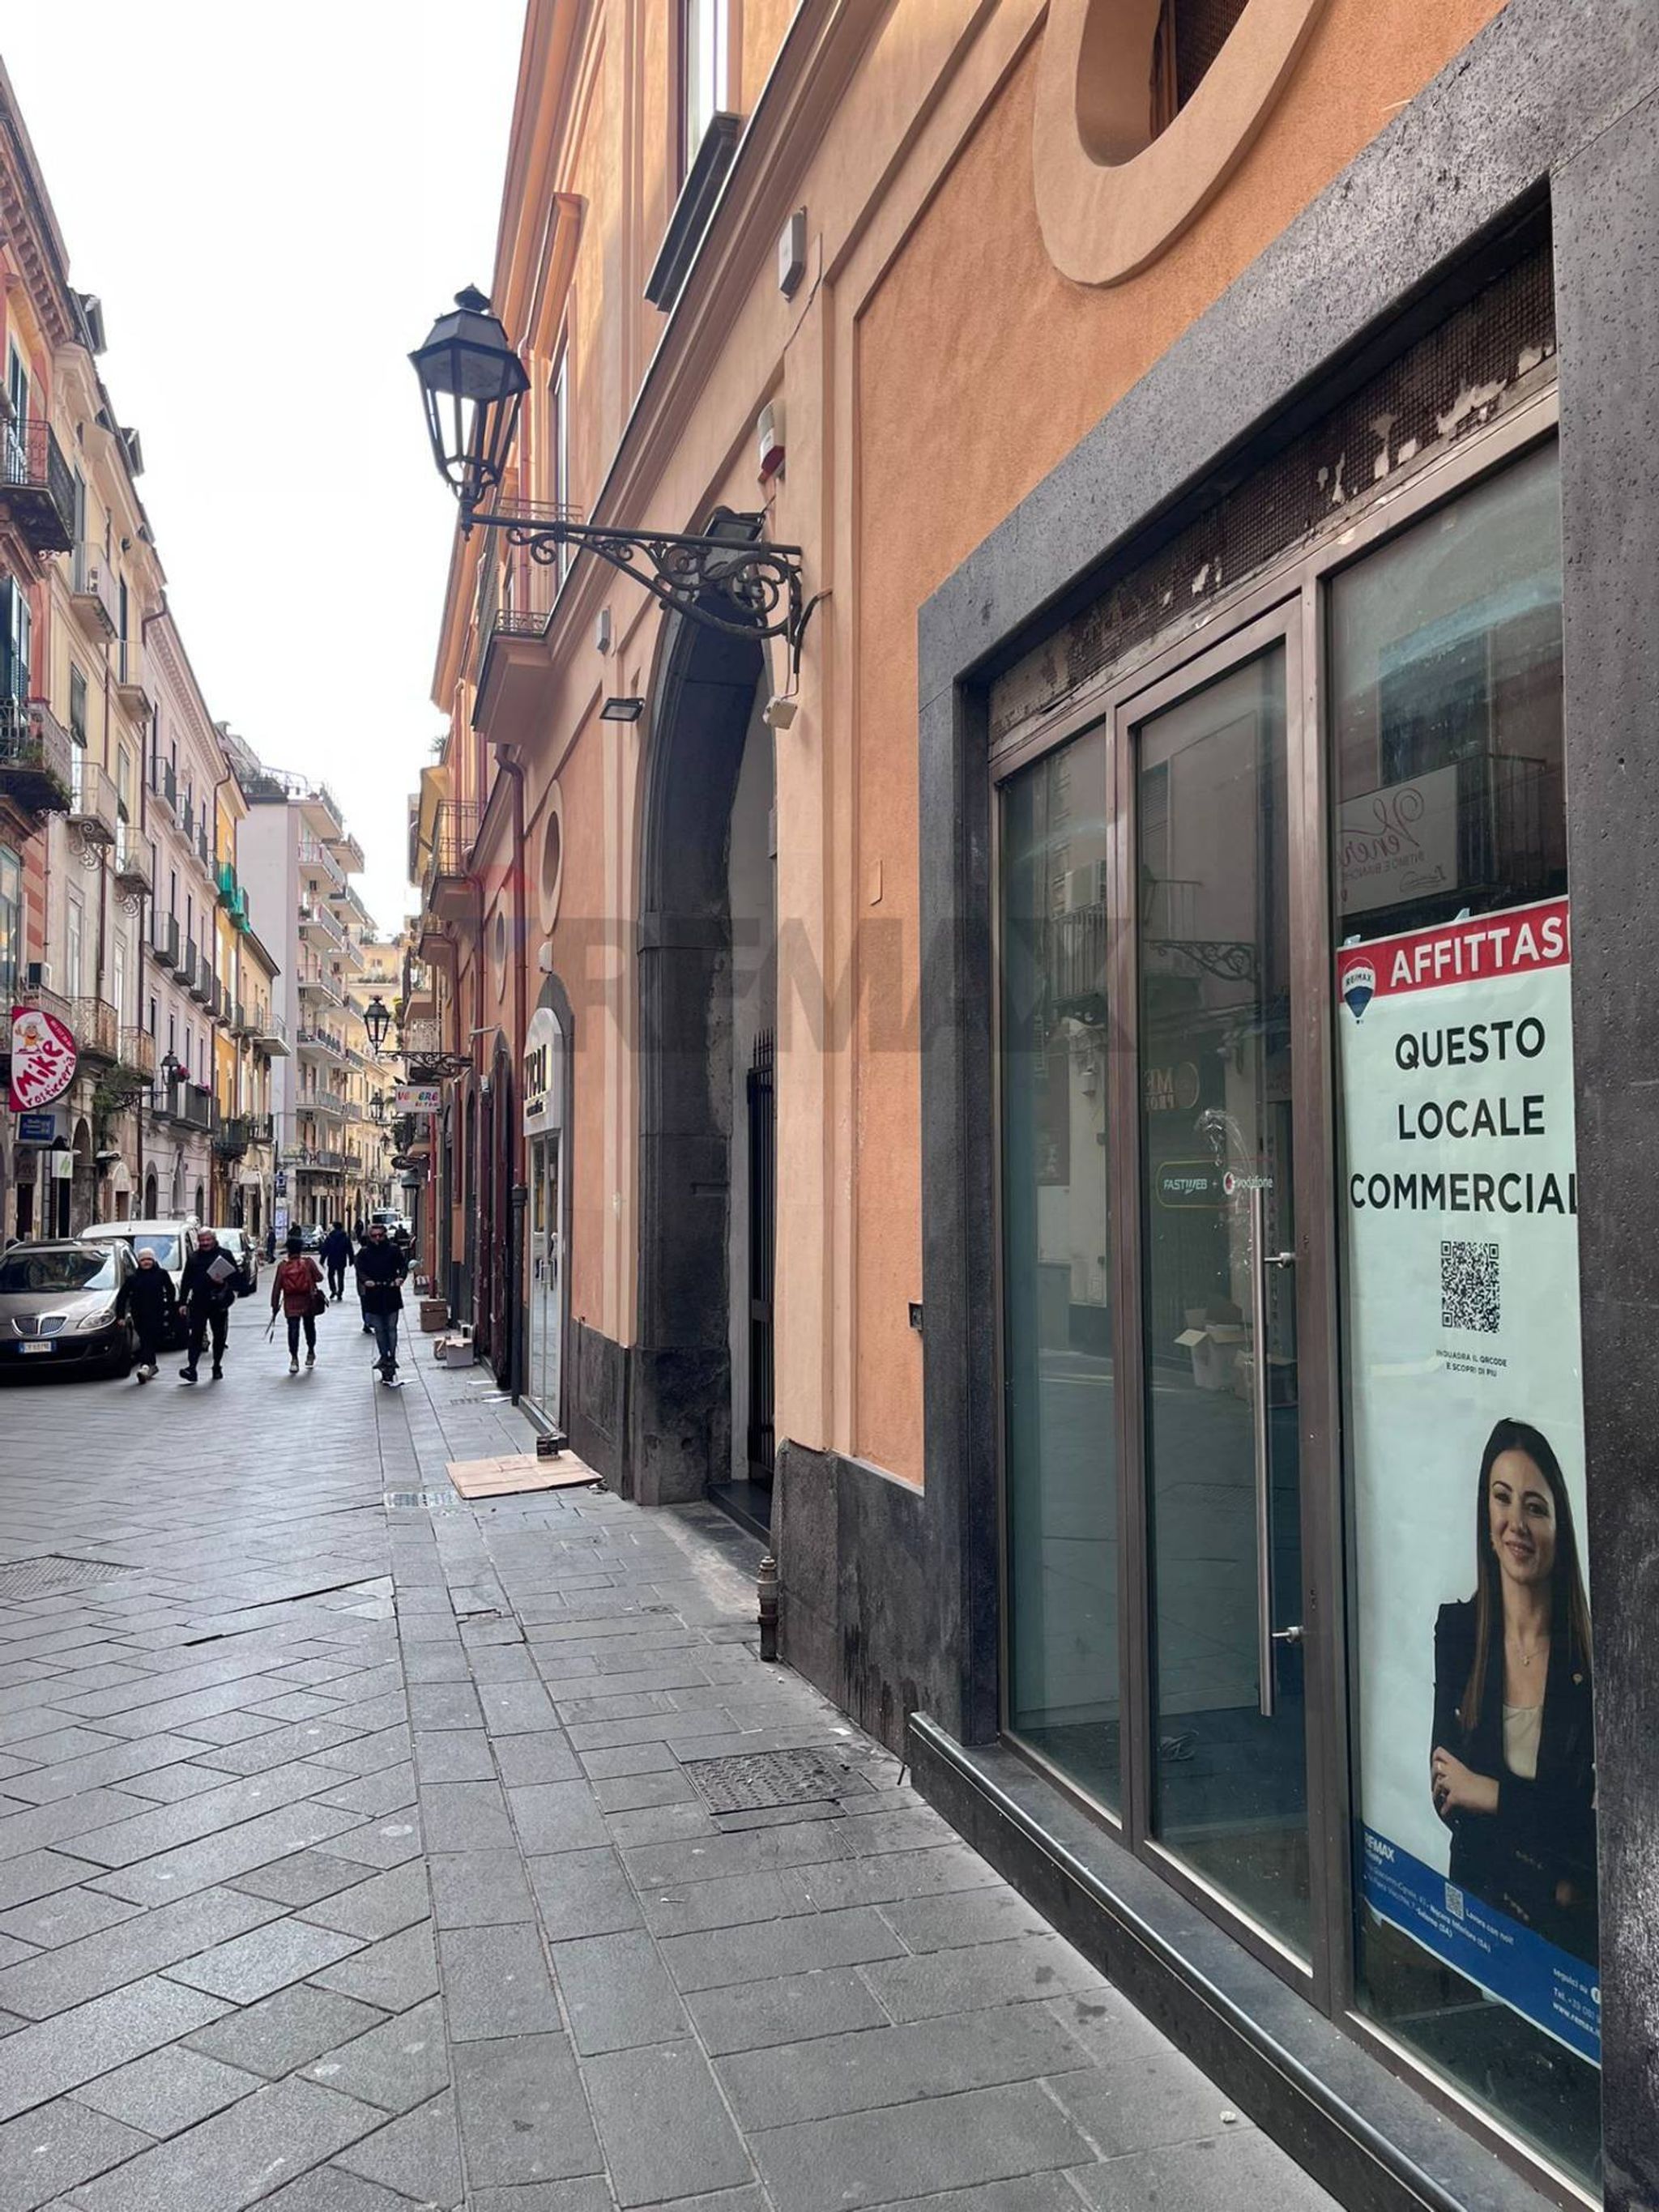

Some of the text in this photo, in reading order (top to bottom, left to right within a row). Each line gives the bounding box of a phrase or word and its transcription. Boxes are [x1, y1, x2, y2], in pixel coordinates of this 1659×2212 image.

[1396, 1016, 1546, 1070] QUESTO
[16, 1040, 64, 1097] Mike
[1398, 1095, 1546, 1140] LOCALE
[1164, 1178, 1208, 1195] FASTWEB
